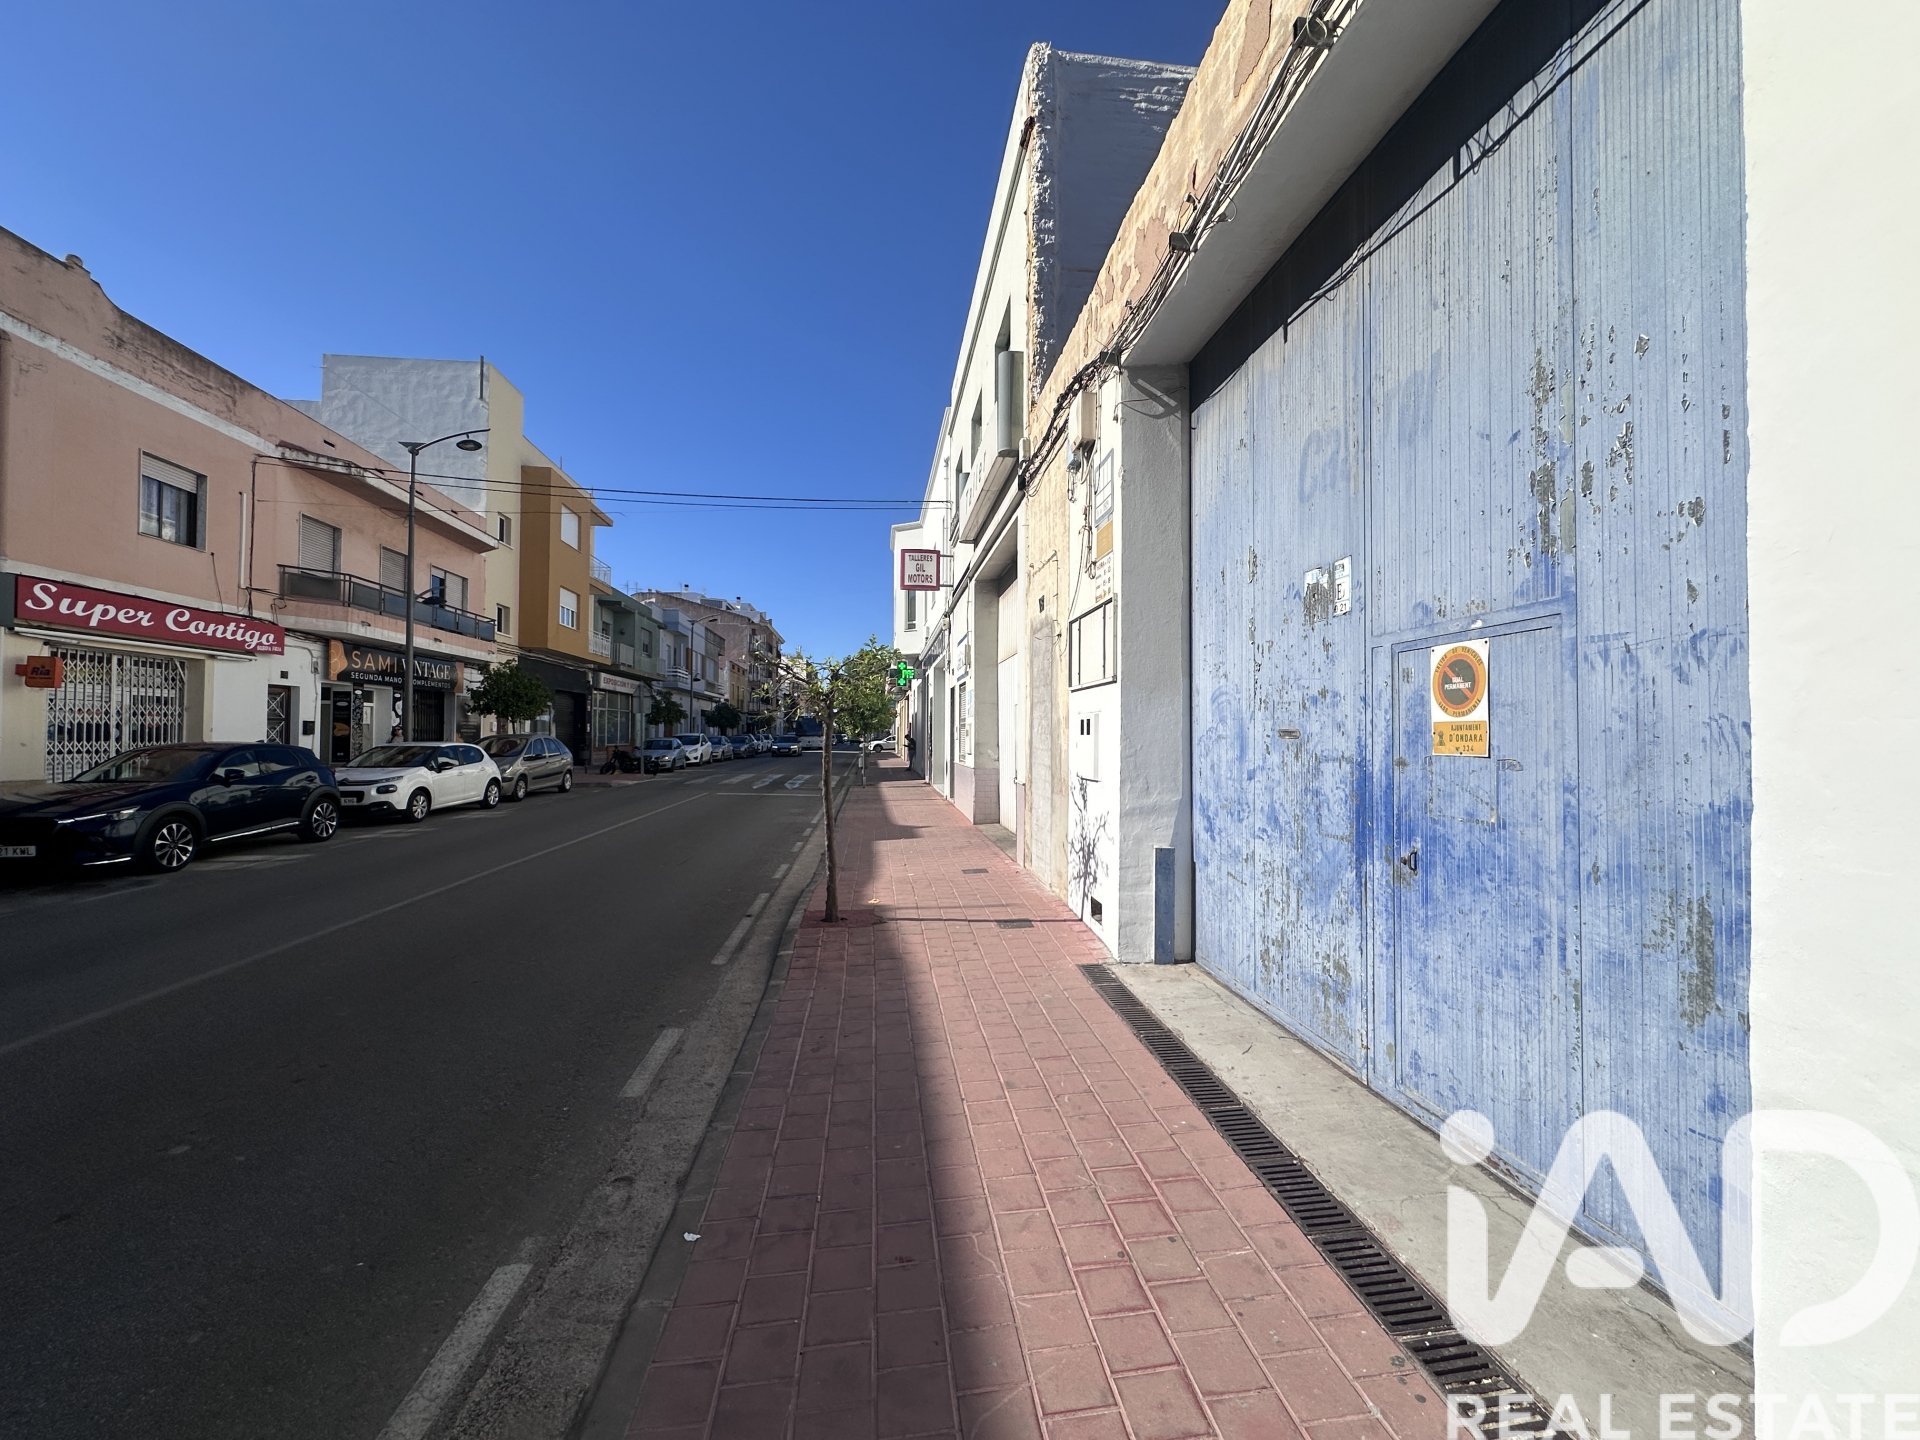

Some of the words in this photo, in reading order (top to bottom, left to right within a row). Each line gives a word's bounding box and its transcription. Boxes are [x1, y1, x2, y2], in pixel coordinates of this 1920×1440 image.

[908, 554, 933, 562] TALLERES
[915, 563, 926, 572] GIL
[908, 574, 933, 583] MOTORS
[25, 583, 154, 627] Super
[165, 609, 277, 649] Contigo
[351, 650, 397, 673] SAMI
[31, 664, 51, 676] Ria
[351, 671, 383, 682] SEGUNDA
[384, 676, 403, 684] MANO
[412, 679, 451, 688] OMPLEMENTOS
